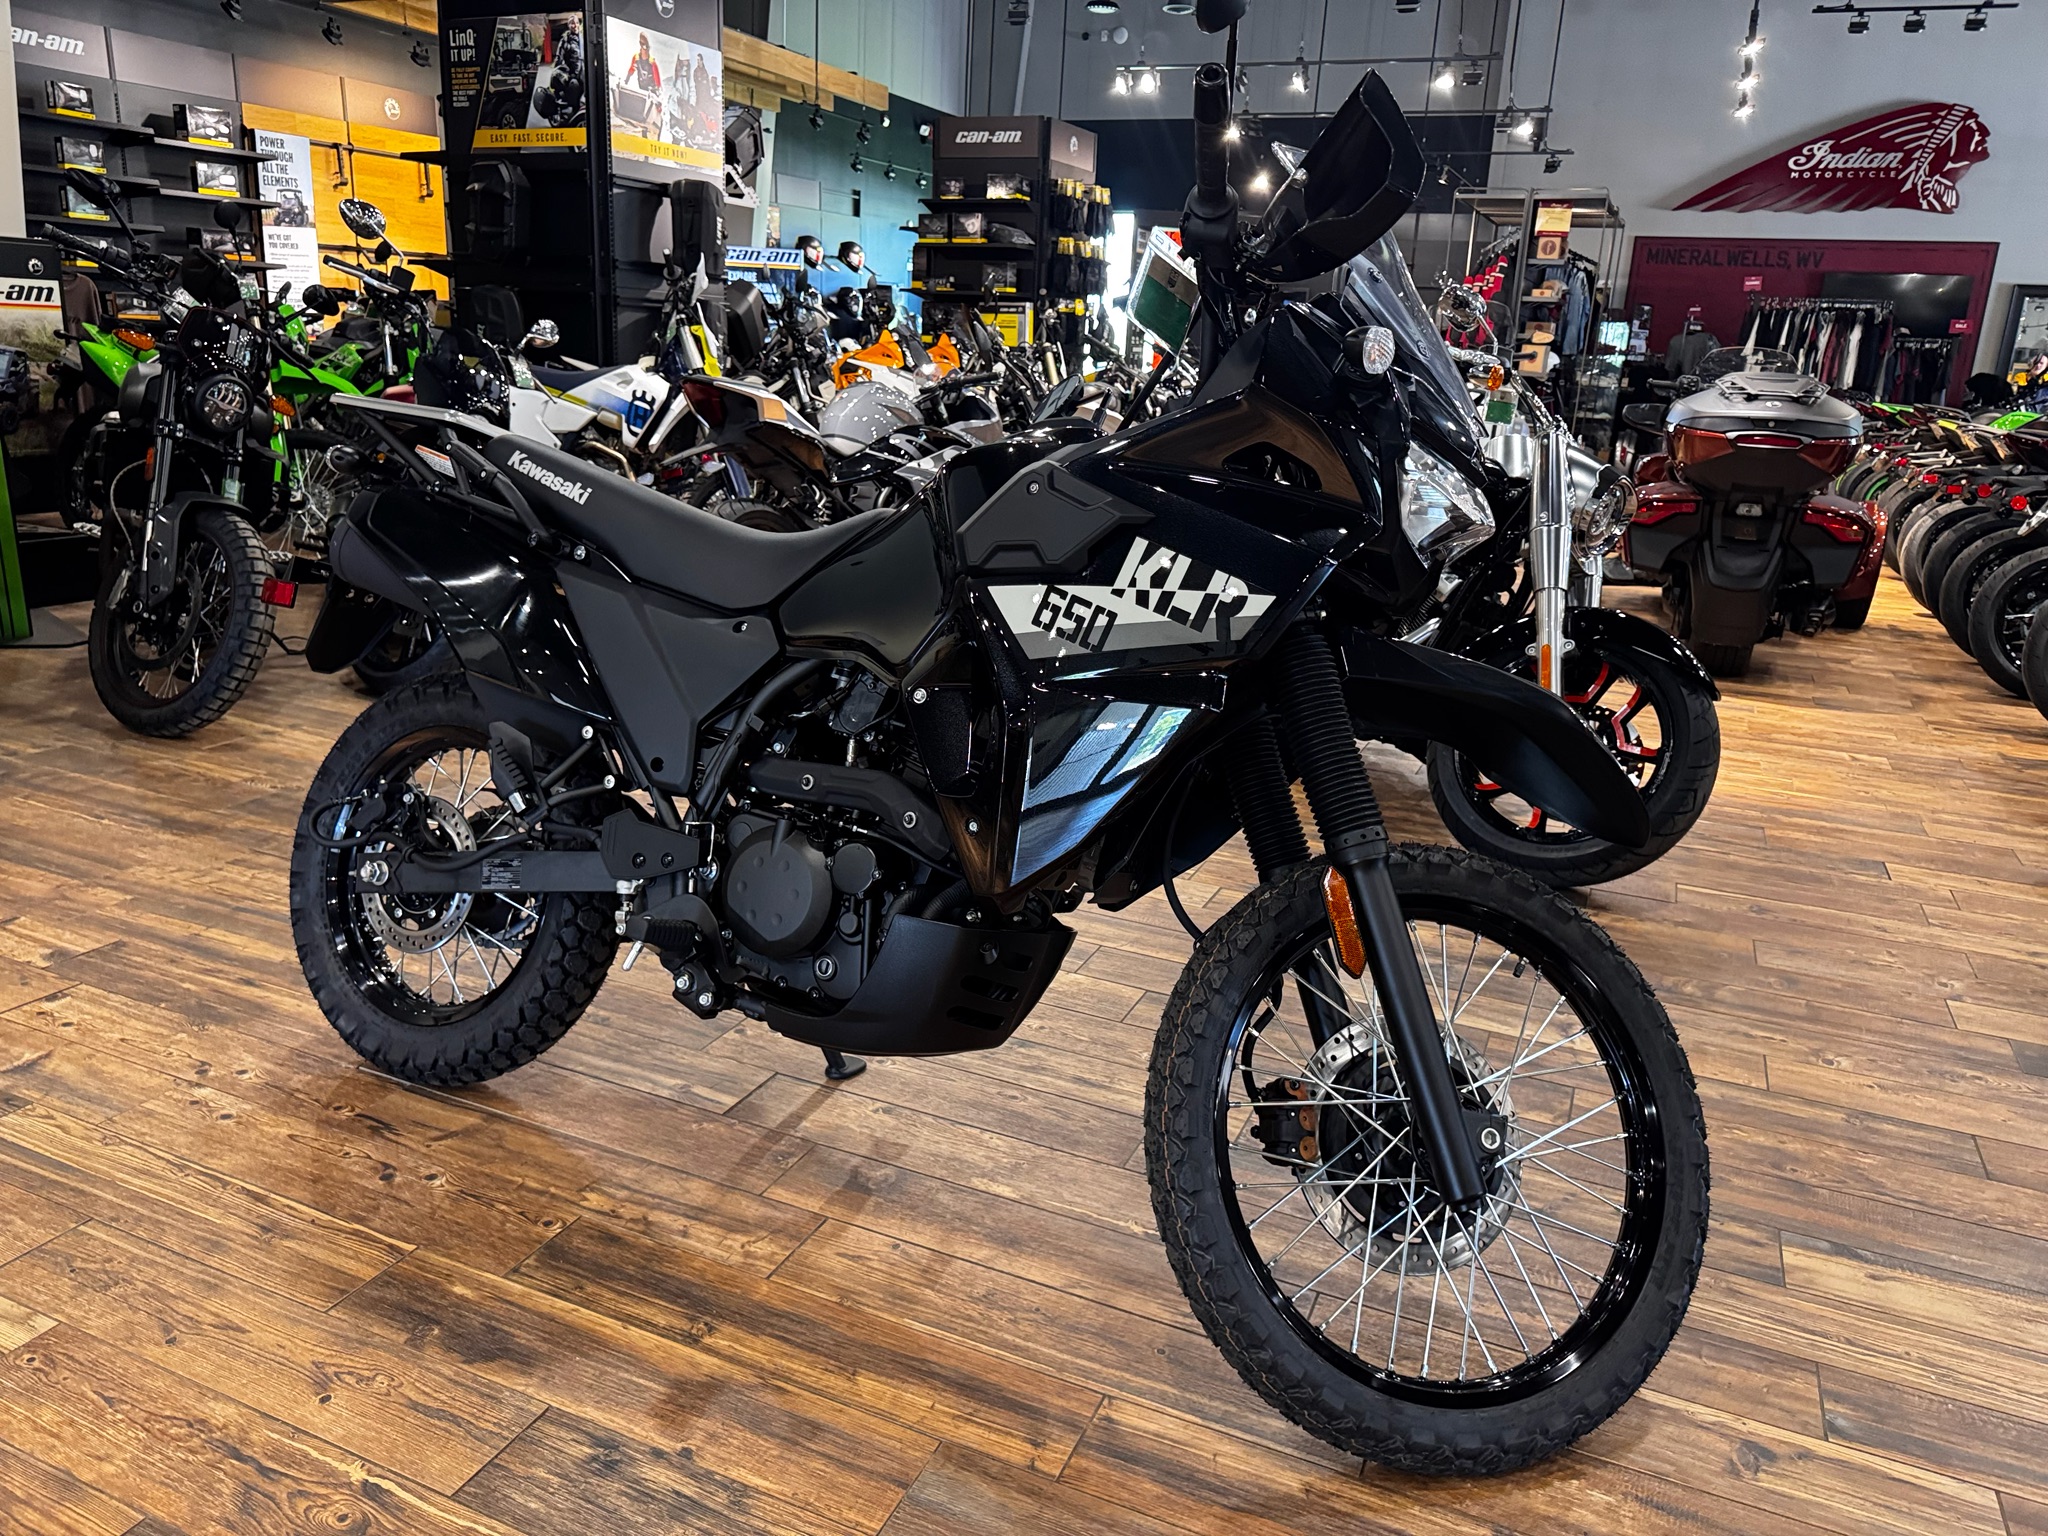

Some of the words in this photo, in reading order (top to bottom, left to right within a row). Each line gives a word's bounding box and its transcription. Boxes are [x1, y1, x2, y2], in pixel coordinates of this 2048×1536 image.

[11, 26, 84, 56] an-am
[449, 28, 475, 47] LinQ
[450, 49, 459, 62] IT
[460, 47, 476, 62] UP!
[259, 135, 285, 149] POWER
[954, 130, 1022, 144] can-am
[1788, 139, 1904, 171] Indian
[262, 162, 275, 174] ALL
[275, 163, 289, 175] THE
[1790, 170, 1897, 179] MOTORCYCLE
[262, 174, 299, 189] ELEMENTS
[726, 248, 800, 264] can-am
[1645, 247, 1725, 267] MINERAL
[1726, 249, 1792, 271] WELLS,
[1795, 251, 1826, 269] WV
[506, 449, 593, 506] Kawasaki
[1110, 536, 1249, 646] KLR
[1031, 584, 1119, 652] 650
